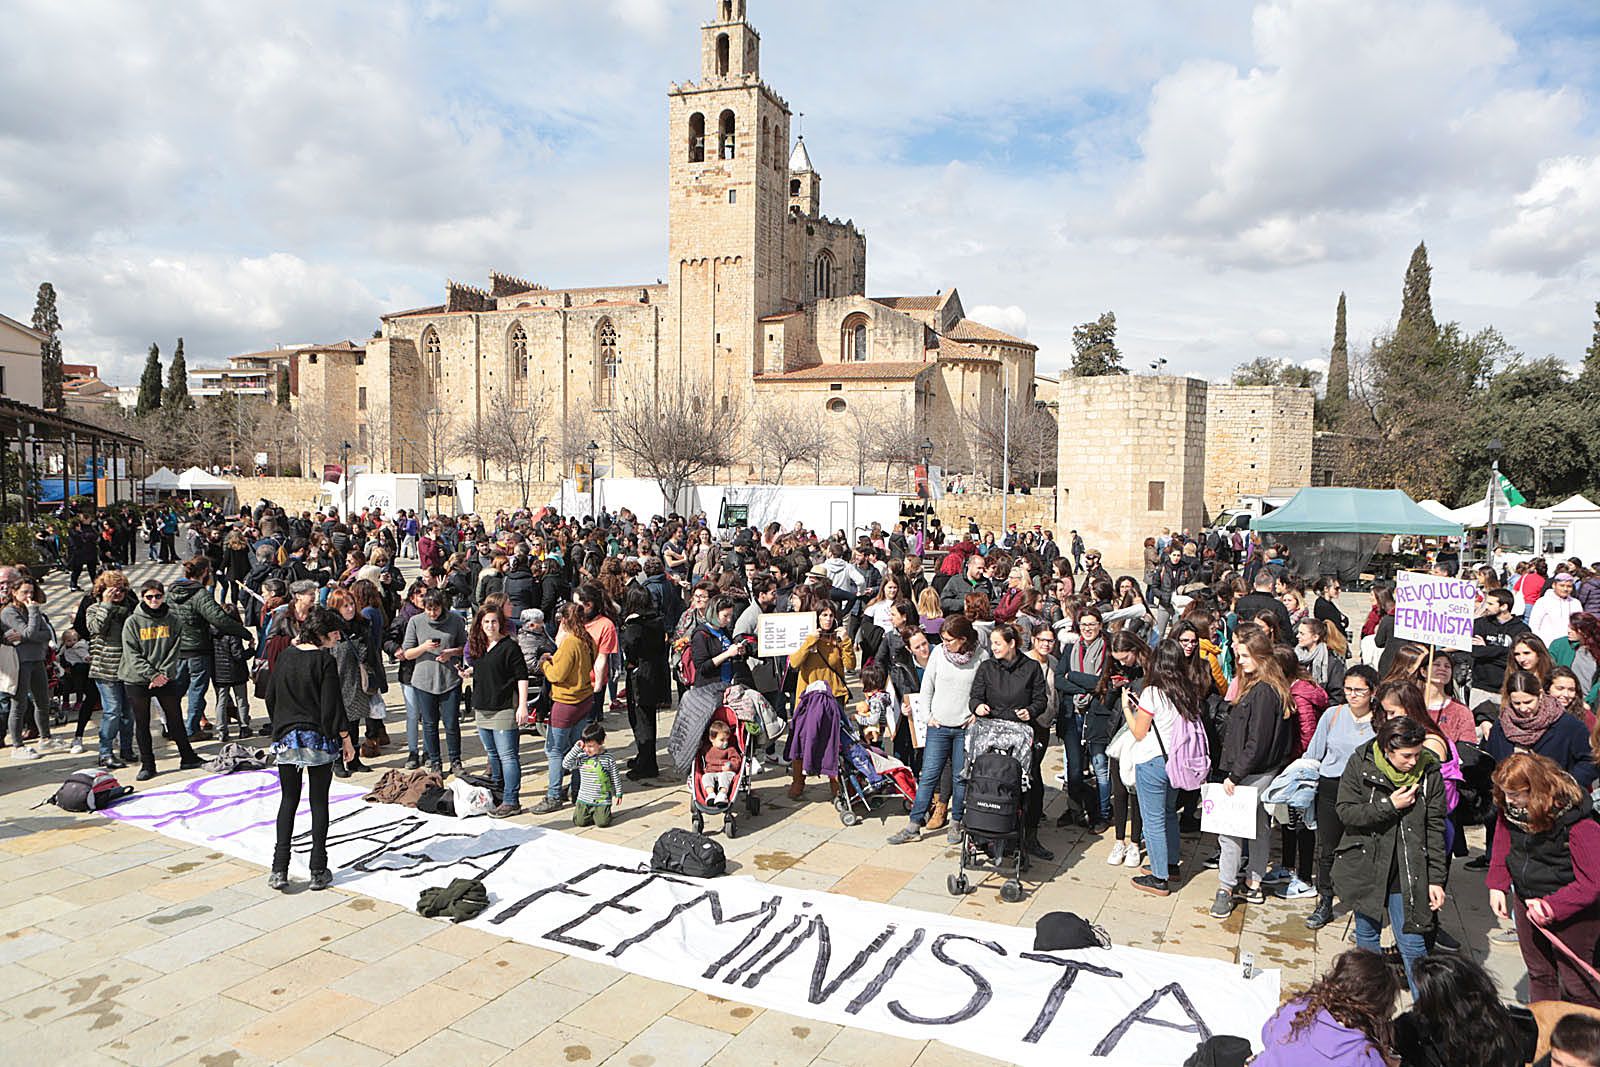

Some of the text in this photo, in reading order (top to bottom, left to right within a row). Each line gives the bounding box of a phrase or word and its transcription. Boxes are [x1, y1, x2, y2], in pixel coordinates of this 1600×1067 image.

[1398, 571, 1409, 581] La
[764, 621, 775, 649] FIGHT
[775, 627, 786, 649] LIKE
